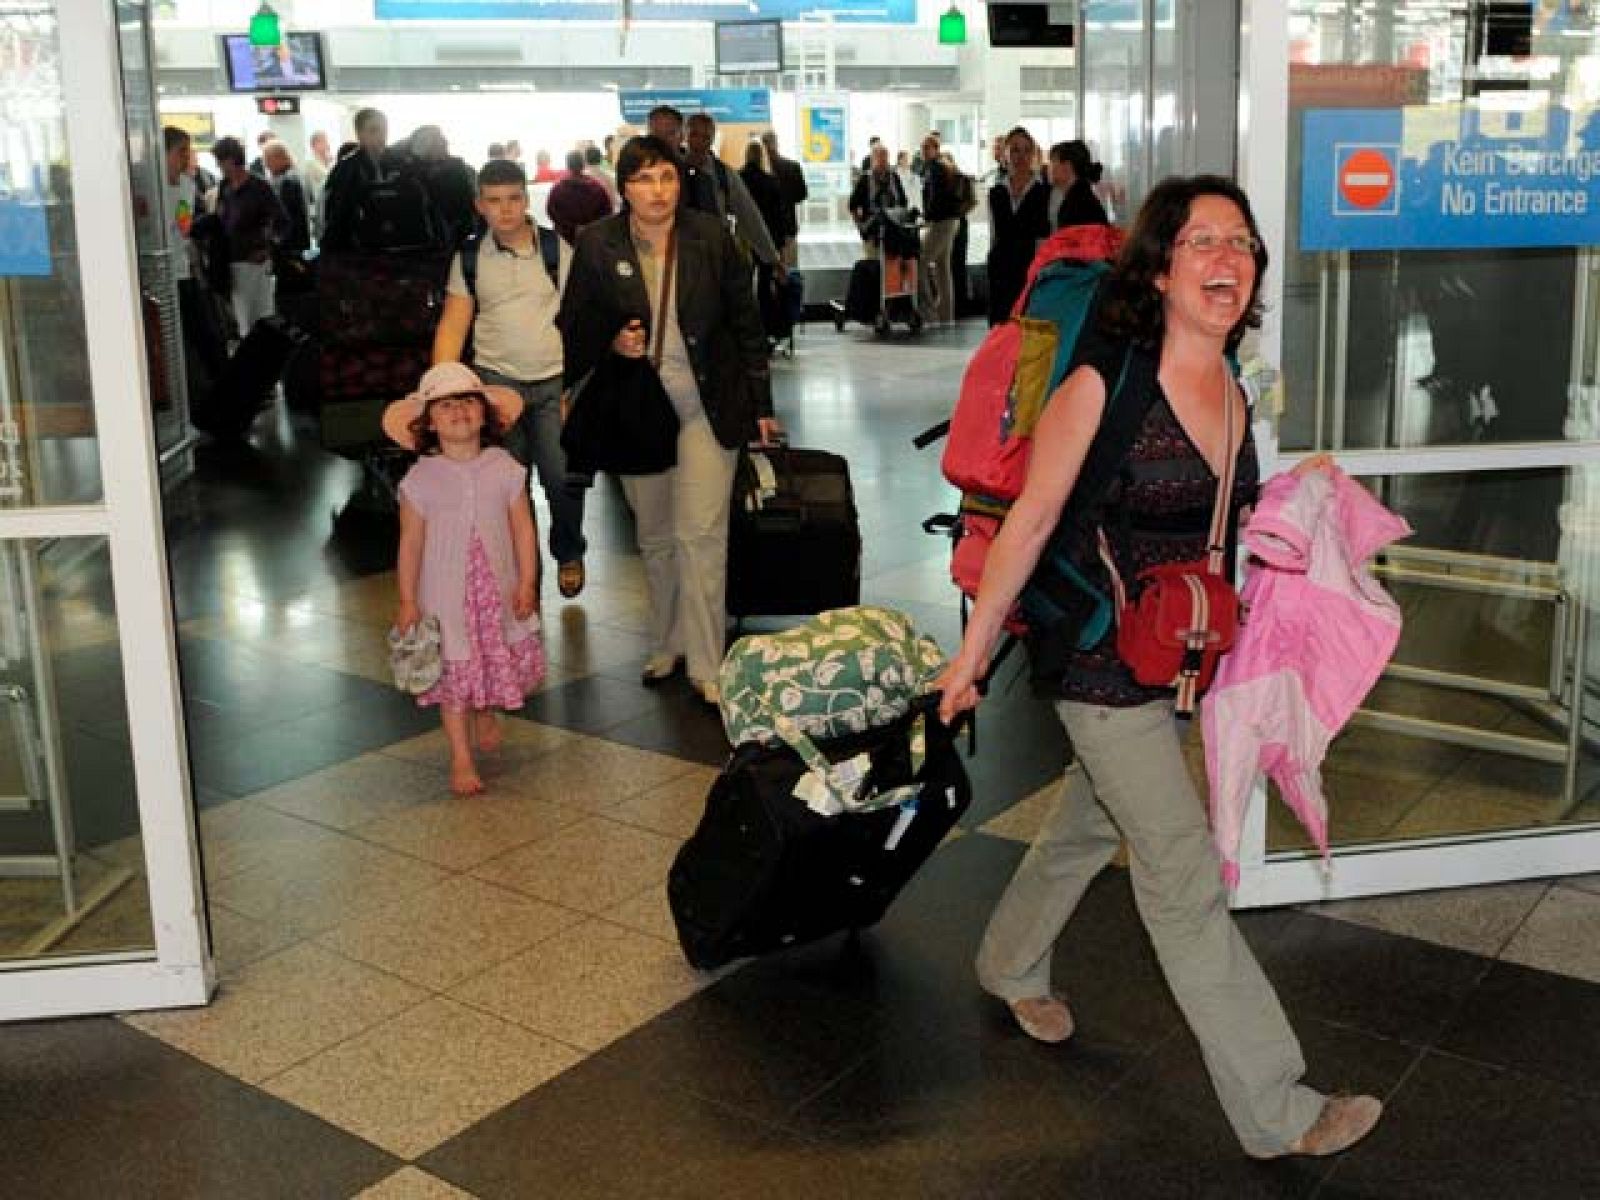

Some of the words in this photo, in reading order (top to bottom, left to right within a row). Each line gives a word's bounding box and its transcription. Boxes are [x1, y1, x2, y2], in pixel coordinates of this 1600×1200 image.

[1444, 143, 1496, 175] Kein
[1441, 182, 1476, 215] No
[1484, 182, 1588, 215] Entrance
